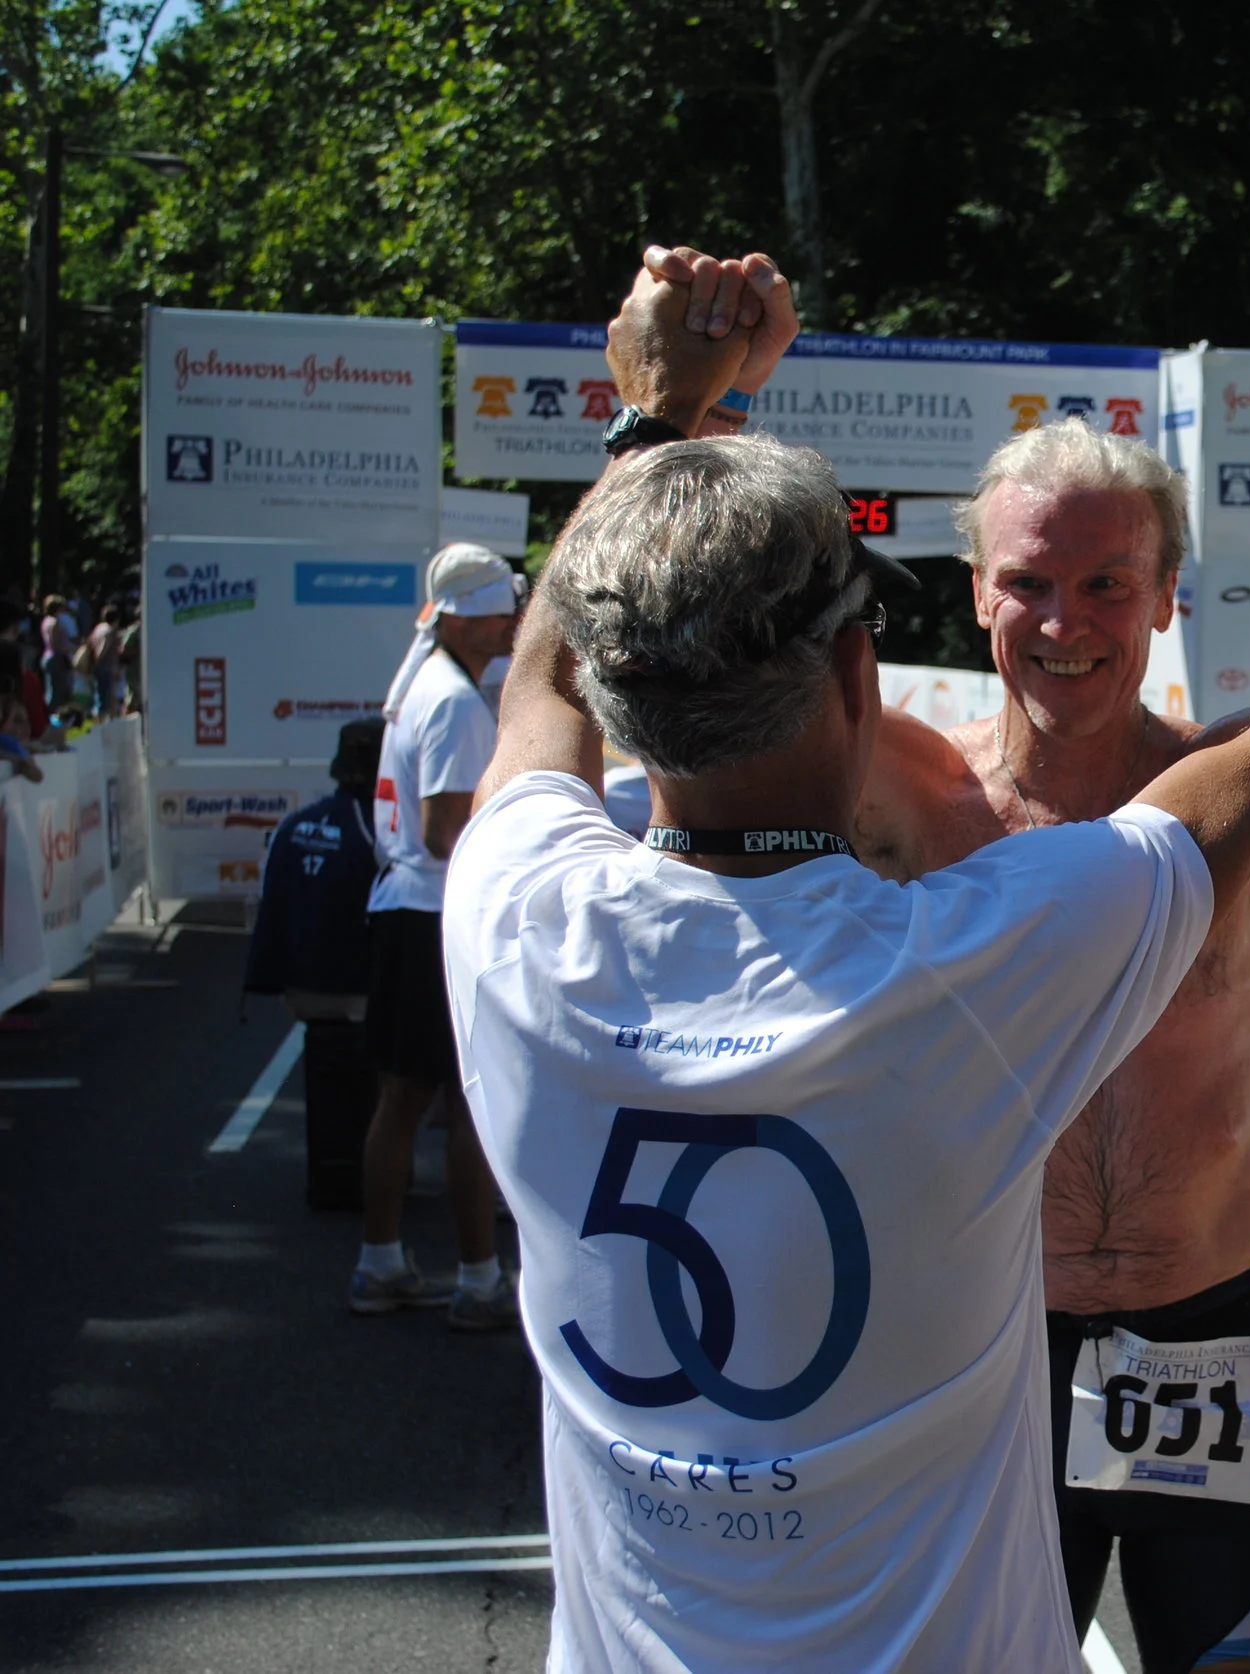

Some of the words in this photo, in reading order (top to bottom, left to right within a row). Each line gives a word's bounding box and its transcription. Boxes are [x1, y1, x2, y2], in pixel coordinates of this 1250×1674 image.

[752, 387, 973, 419] HILADELPHIA
[849, 418, 974, 443] COMPANIES
[223, 438, 420, 474] PHILADELPHIA
[849, 499, 889, 533] 26
[192, 564, 219, 582] All
[167, 578, 257, 607] Whites
[199, 661, 223, 726] CLIF
[644, 827, 690, 851] HLYTRI
[765, 830, 851, 855] PHLYTRI
[302, 855, 324, 876] 17
[559, 1106, 871, 1421] 50
[1125, 1355, 1236, 1380] TRIATHLON
[1104, 1374, 1244, 1463] 651
[609, 1439, 799, 1493] CARES
